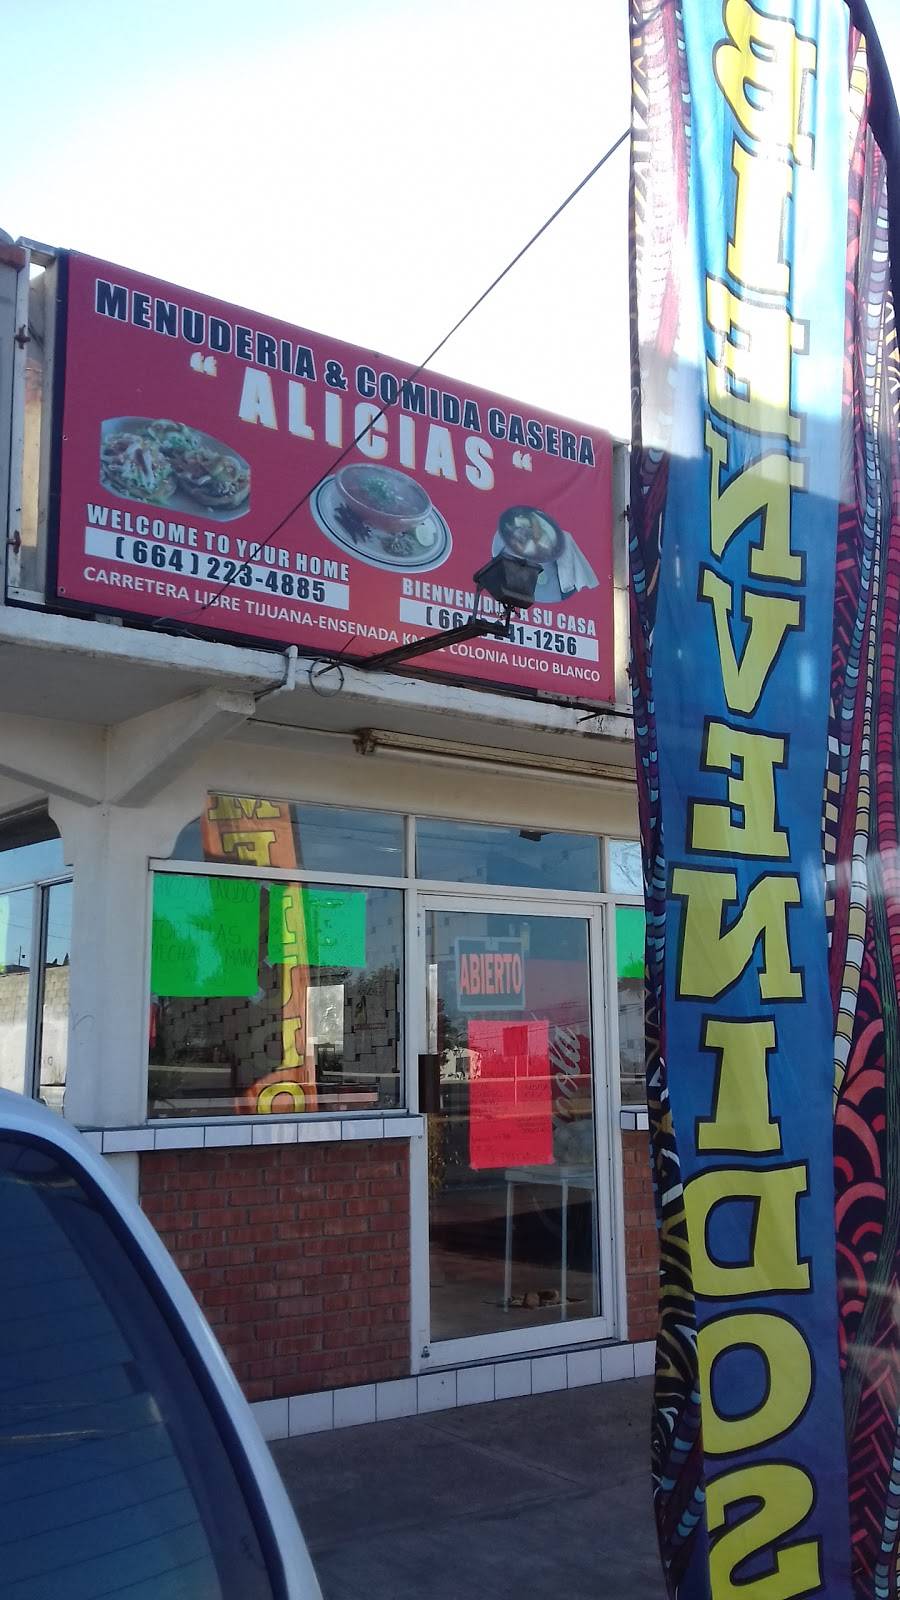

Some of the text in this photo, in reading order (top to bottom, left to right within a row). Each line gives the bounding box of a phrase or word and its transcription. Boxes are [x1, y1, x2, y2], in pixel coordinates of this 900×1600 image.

[95, 278, 596, 467] MENUDERIA & COMIDA CASERA
[238, 366, 495, 490] ALICIAS
[87, 503, 350, 582] WELCOME TO YOUR HOME
[83, 566, 190, 601] CARRETERA
[195, 589, 241, 612] LIBRE
[245, 600, 399, 643] TIJUANA-ENSENADA
[449, 643, 509, 666] COLONIA
[512, 654, 549, 672] LUCIO
[552, 663, 600, 682] BLANCO
[402, 577, 516, 618] BIENVENIDO
[532, 607, 553, 627] SU
[557, 614, 597, 636] CASA
[494, 619, 577, 656] 41-1256
[458, 953, 524, 996] ABIERTO
